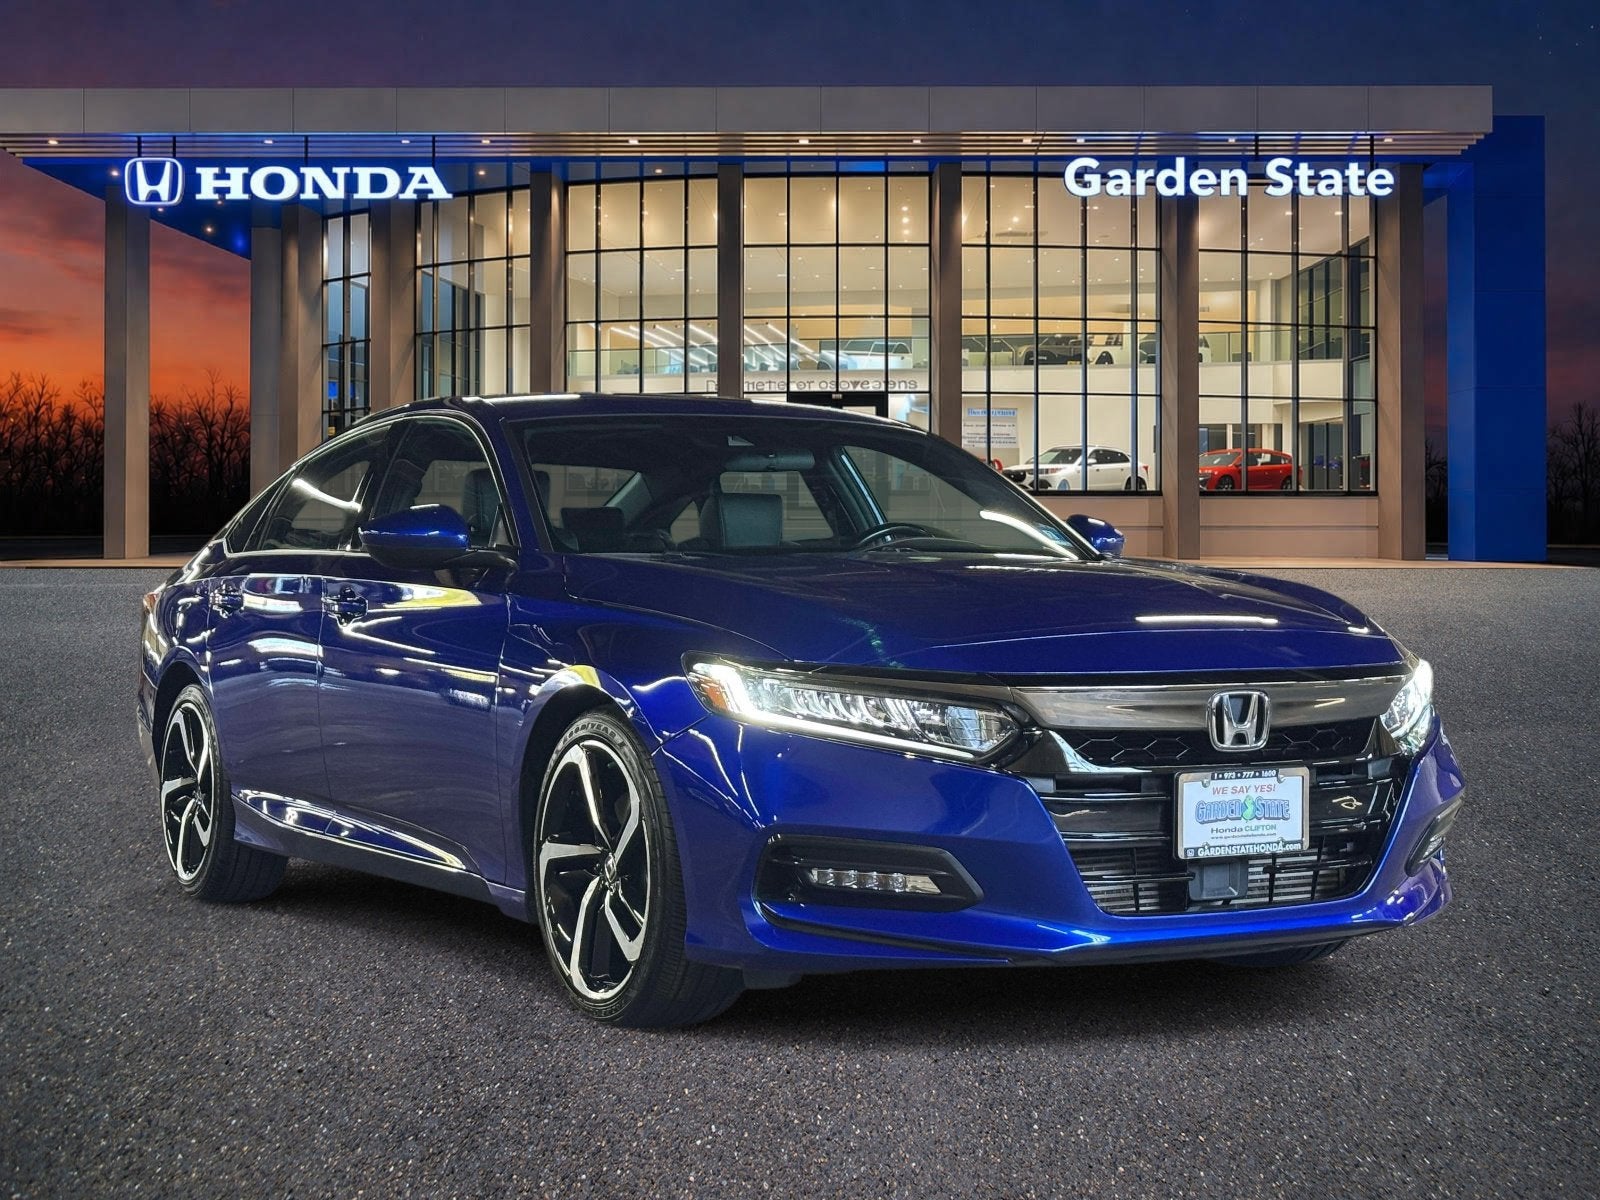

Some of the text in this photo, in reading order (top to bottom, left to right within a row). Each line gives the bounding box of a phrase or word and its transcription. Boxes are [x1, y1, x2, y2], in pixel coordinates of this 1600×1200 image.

[194, 165, 454, 201] HONDA
[1063, 156, 1395, 197] Garden State
[1223, 772, 1236, 780] 973
[1212, 783, 1276, 796] WE SAY YES!
[1195, 796, 1290, 824] GARDEN STATE
[1210, 824, 1277, 834] Honda CLIFTON
[1197, 841, 1301, 857] GARDENSTATEHONDA.com
